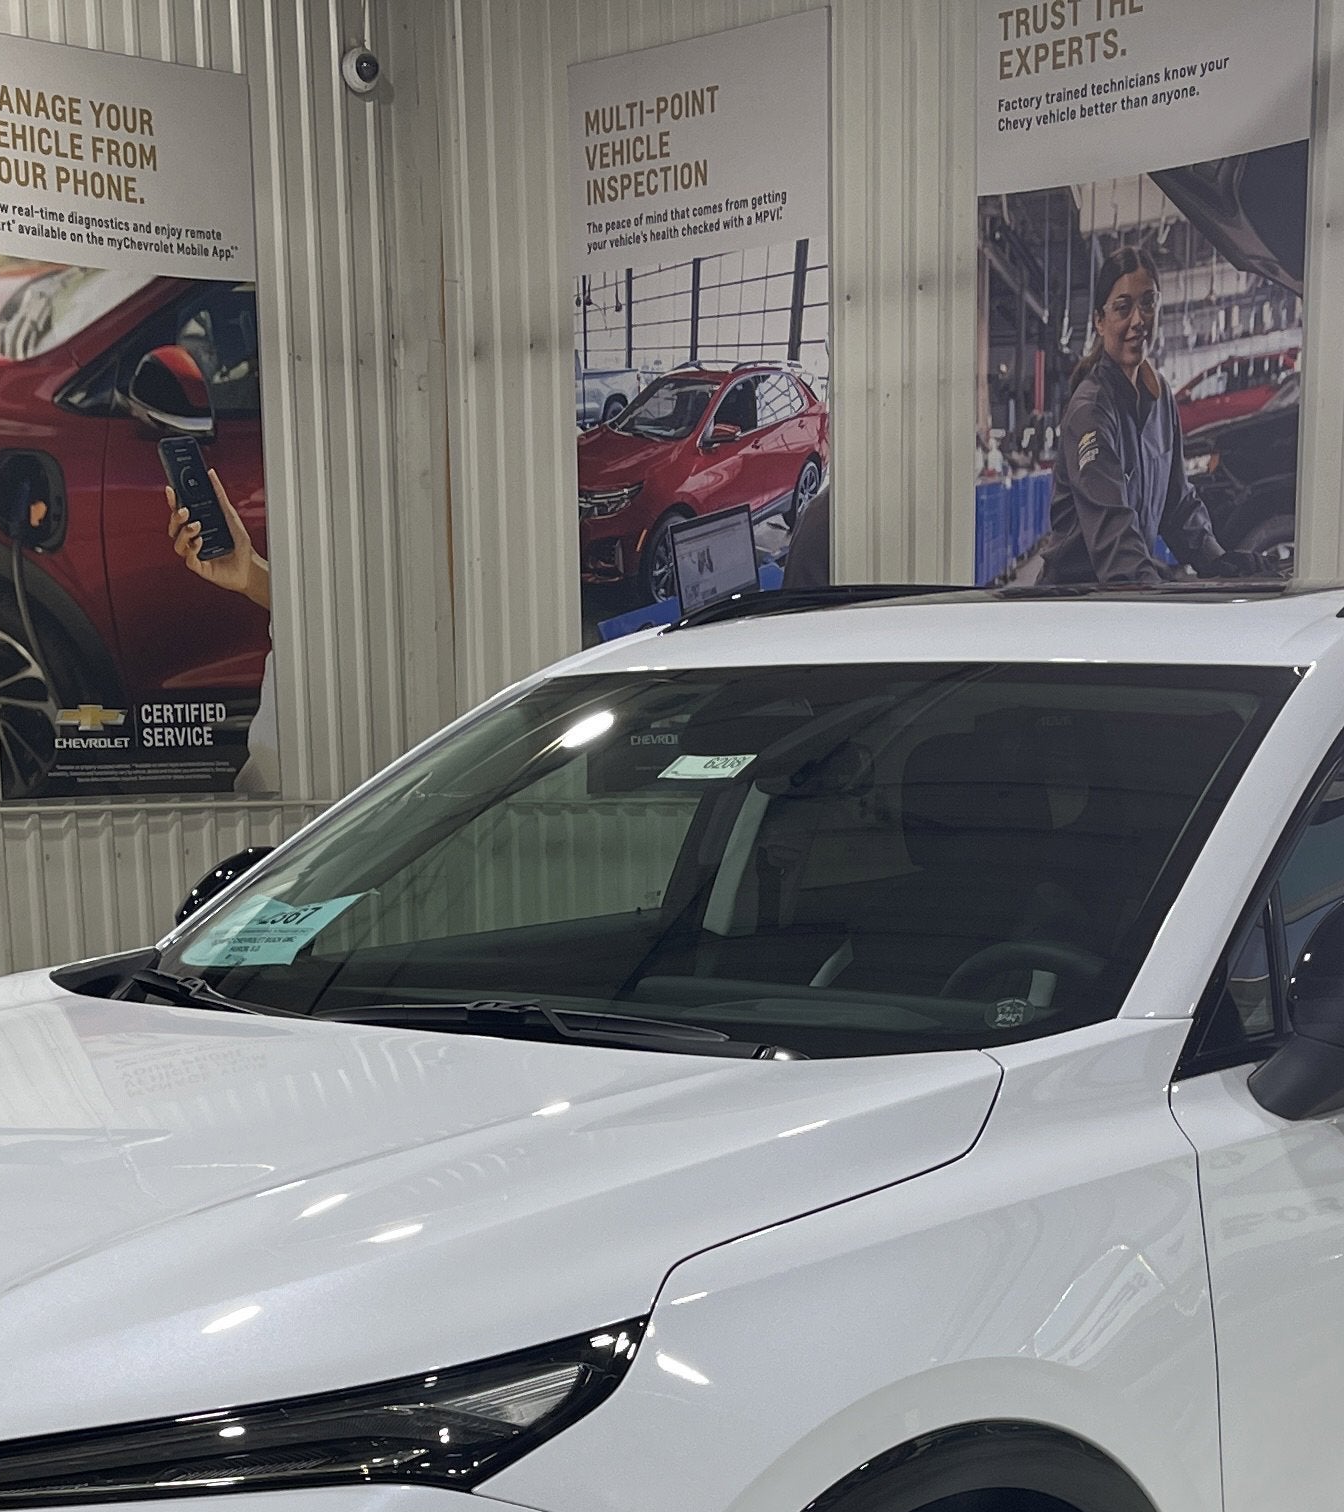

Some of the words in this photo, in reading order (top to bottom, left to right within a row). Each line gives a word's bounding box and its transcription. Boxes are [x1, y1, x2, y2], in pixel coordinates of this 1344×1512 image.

[998, 0, 1082, 41] TRUST
[999, 28, 1127, 80] EXPERTS.
[998, 93, 1043, 112] Factory
[1045, 84, 1088, 104] trained
[1090, 72, 1161, 99] technicians
[1163, 63, 1197, 82] know
[1200, 56, 1231, 76] your
[89, 100, 155, 136] YOUR
[584, 85, 720, 137] MULTI-POINT
[998, 115, 1033, 132] Chevy
[1036, 105, 1077, 125] vehicle
[1079, 101, 1118, 118] better
[1120, 96, 1148, 112] than
[1151, 84, 1200, 106] anyone.
[91, 136, 158, 172] FROM
[584, 130, 671, 171] VEHICLE
[56, 165, 146, 205] PHONE.
[586, 159, 709, 206] INSPECTION
[12, 204, 65, 223] real-time
[68, 211, 131, 233] diagnostics
[133, 221, 152, 235] and
[155, 225, 183, 241] enjoy
[185, 227, 222, 241] remote
[587, 220, 604, 235] The
[605, 217, 632, 236] peace
[633, 212, 644, 227] of
[646, 209, 669, 226] mind
[670, 206, 691, 221] that
[692, 203, 724, 218] comes
[725, 197, 750, 212] from
[751, 190, 788, 210] getting
[18, 222, 67, 241] available
[70, 234, 84, 244] on
[86, 232, 104, 246] the
[107, 234, 175, 254] myChevrolet
[176, 242, 210, 258] Mobile
[587, 239, 608, 255] your
[609, 229, 648, 248] vehicle's
[650, 227, 680, 242] health
[681, 217, 721, 237] checked
[723, 214, 745, 230] with
[747, 216, 753, 226] a
[141, 703, 226, 724] CERTIFIED
[54, 737, 130, 749] CHEVROLET
[142, 726, 214, 748] SERVICE
